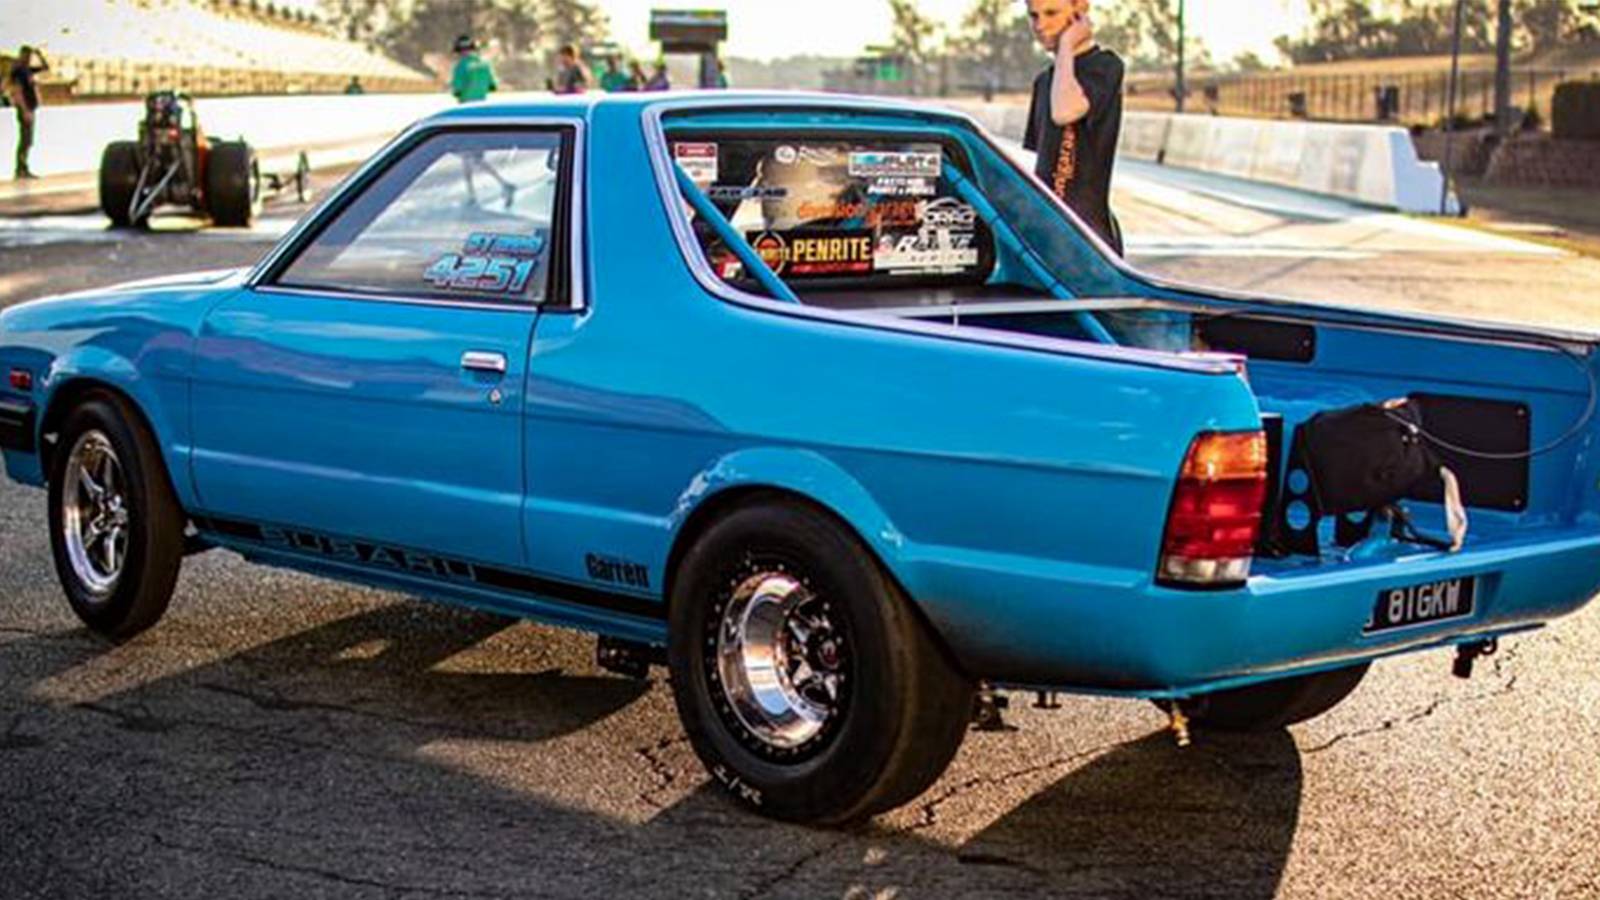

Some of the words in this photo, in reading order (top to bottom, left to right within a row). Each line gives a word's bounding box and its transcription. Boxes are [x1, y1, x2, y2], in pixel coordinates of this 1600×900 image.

[792, 237, 871, 262] PENRITE
[423, 253, 534, 293] 4251
[260, 526, 478, 583] SUBARU
